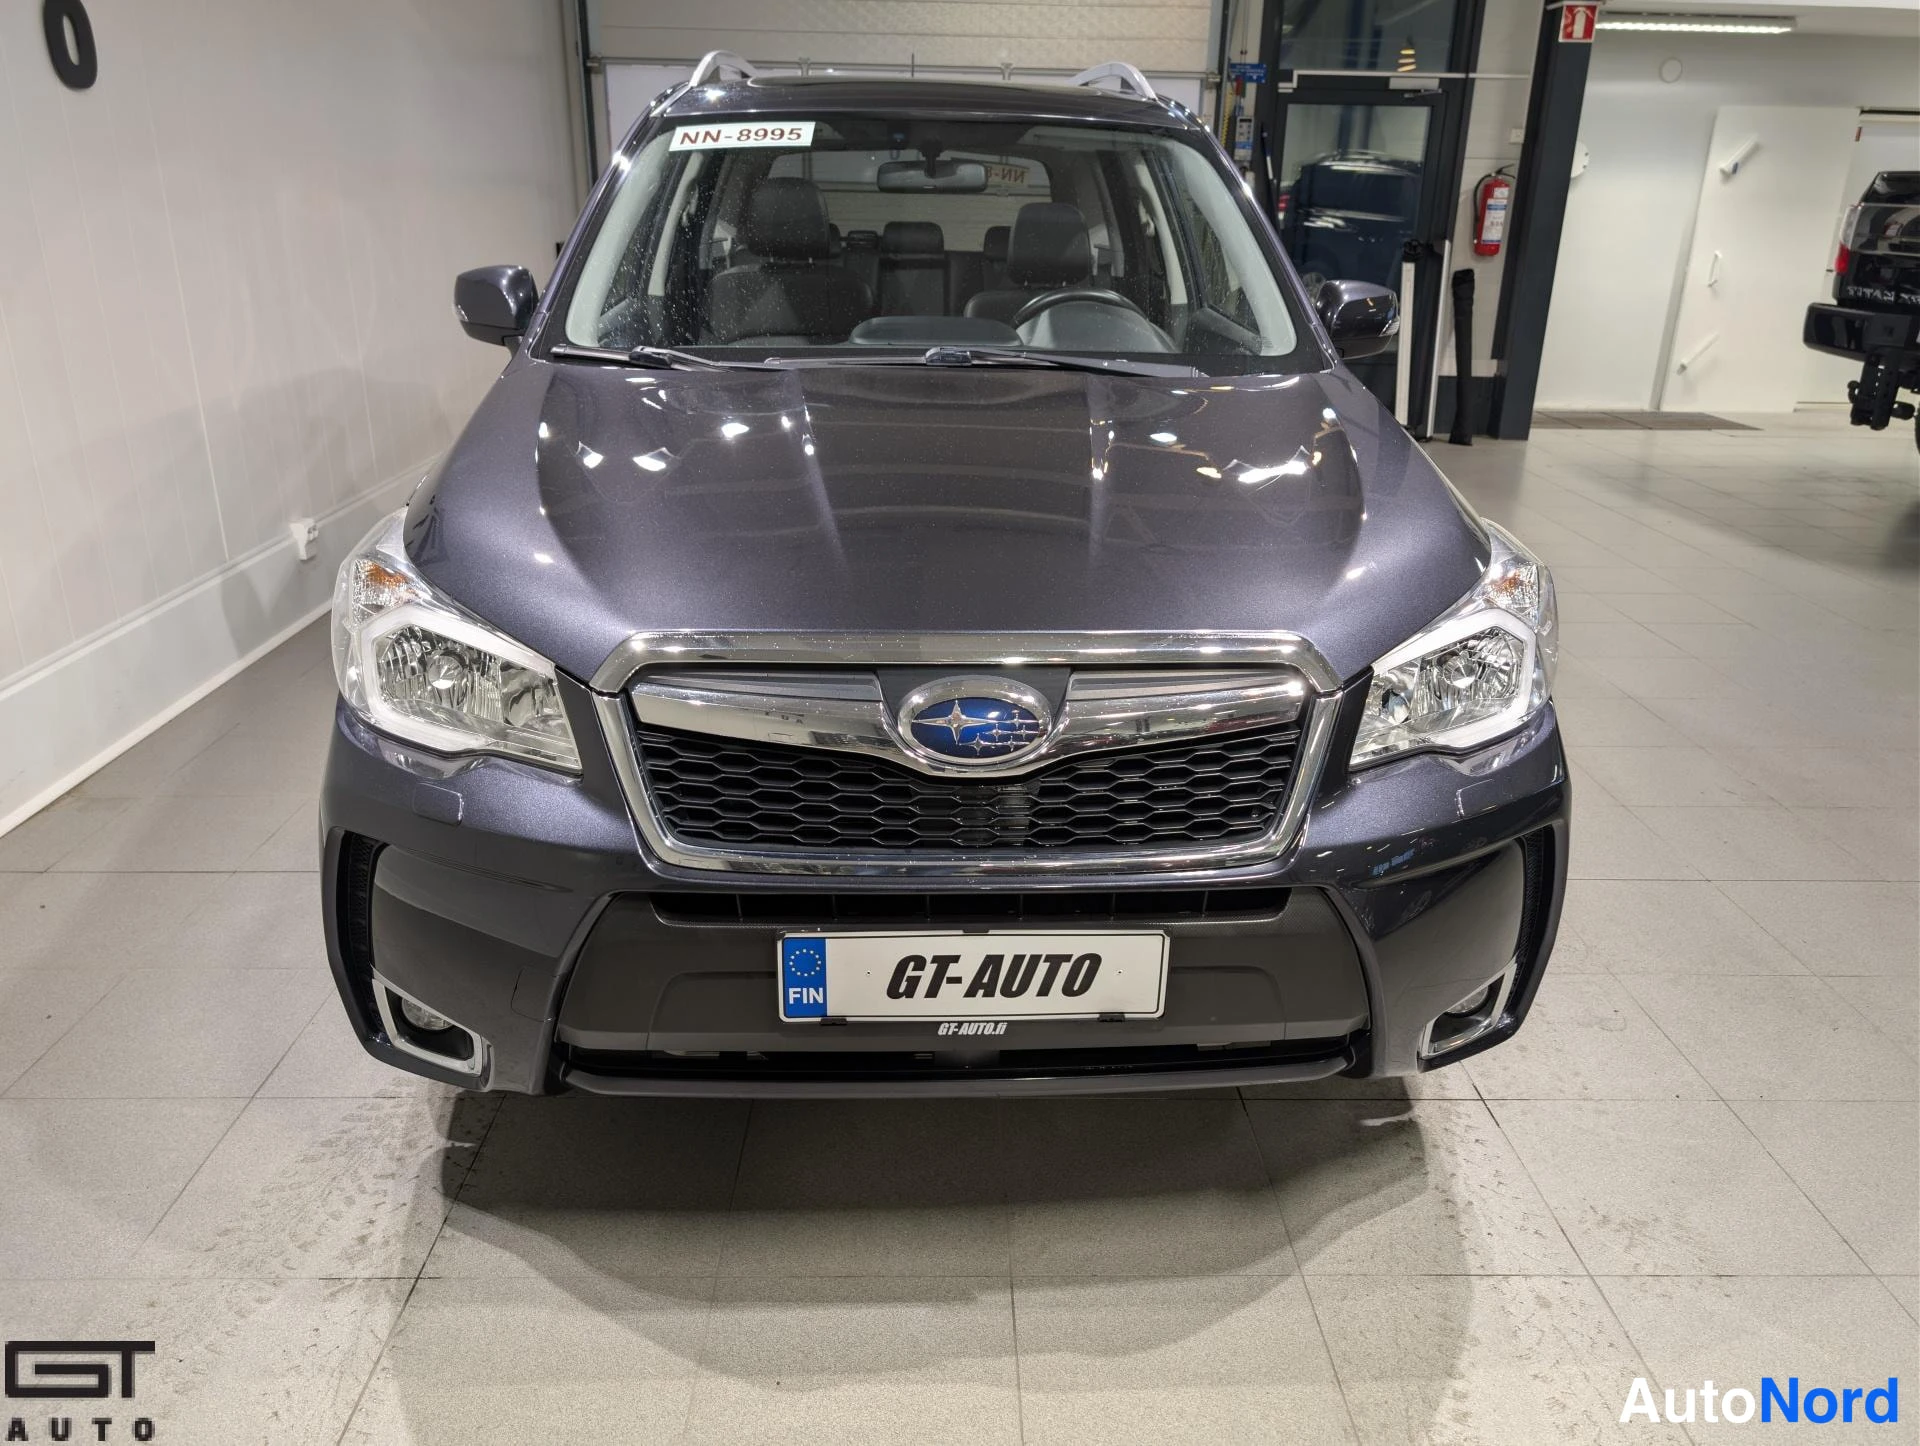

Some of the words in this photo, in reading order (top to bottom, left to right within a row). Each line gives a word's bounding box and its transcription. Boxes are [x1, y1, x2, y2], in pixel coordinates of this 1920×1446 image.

[679, 127, 803, 145] NN-8995
[886, 952, 1103, 1000] GT-AUTO
[789, 987, 824, 1004] FIN
[937, 1022, 1008, 1036] GT-AUTO.fi
